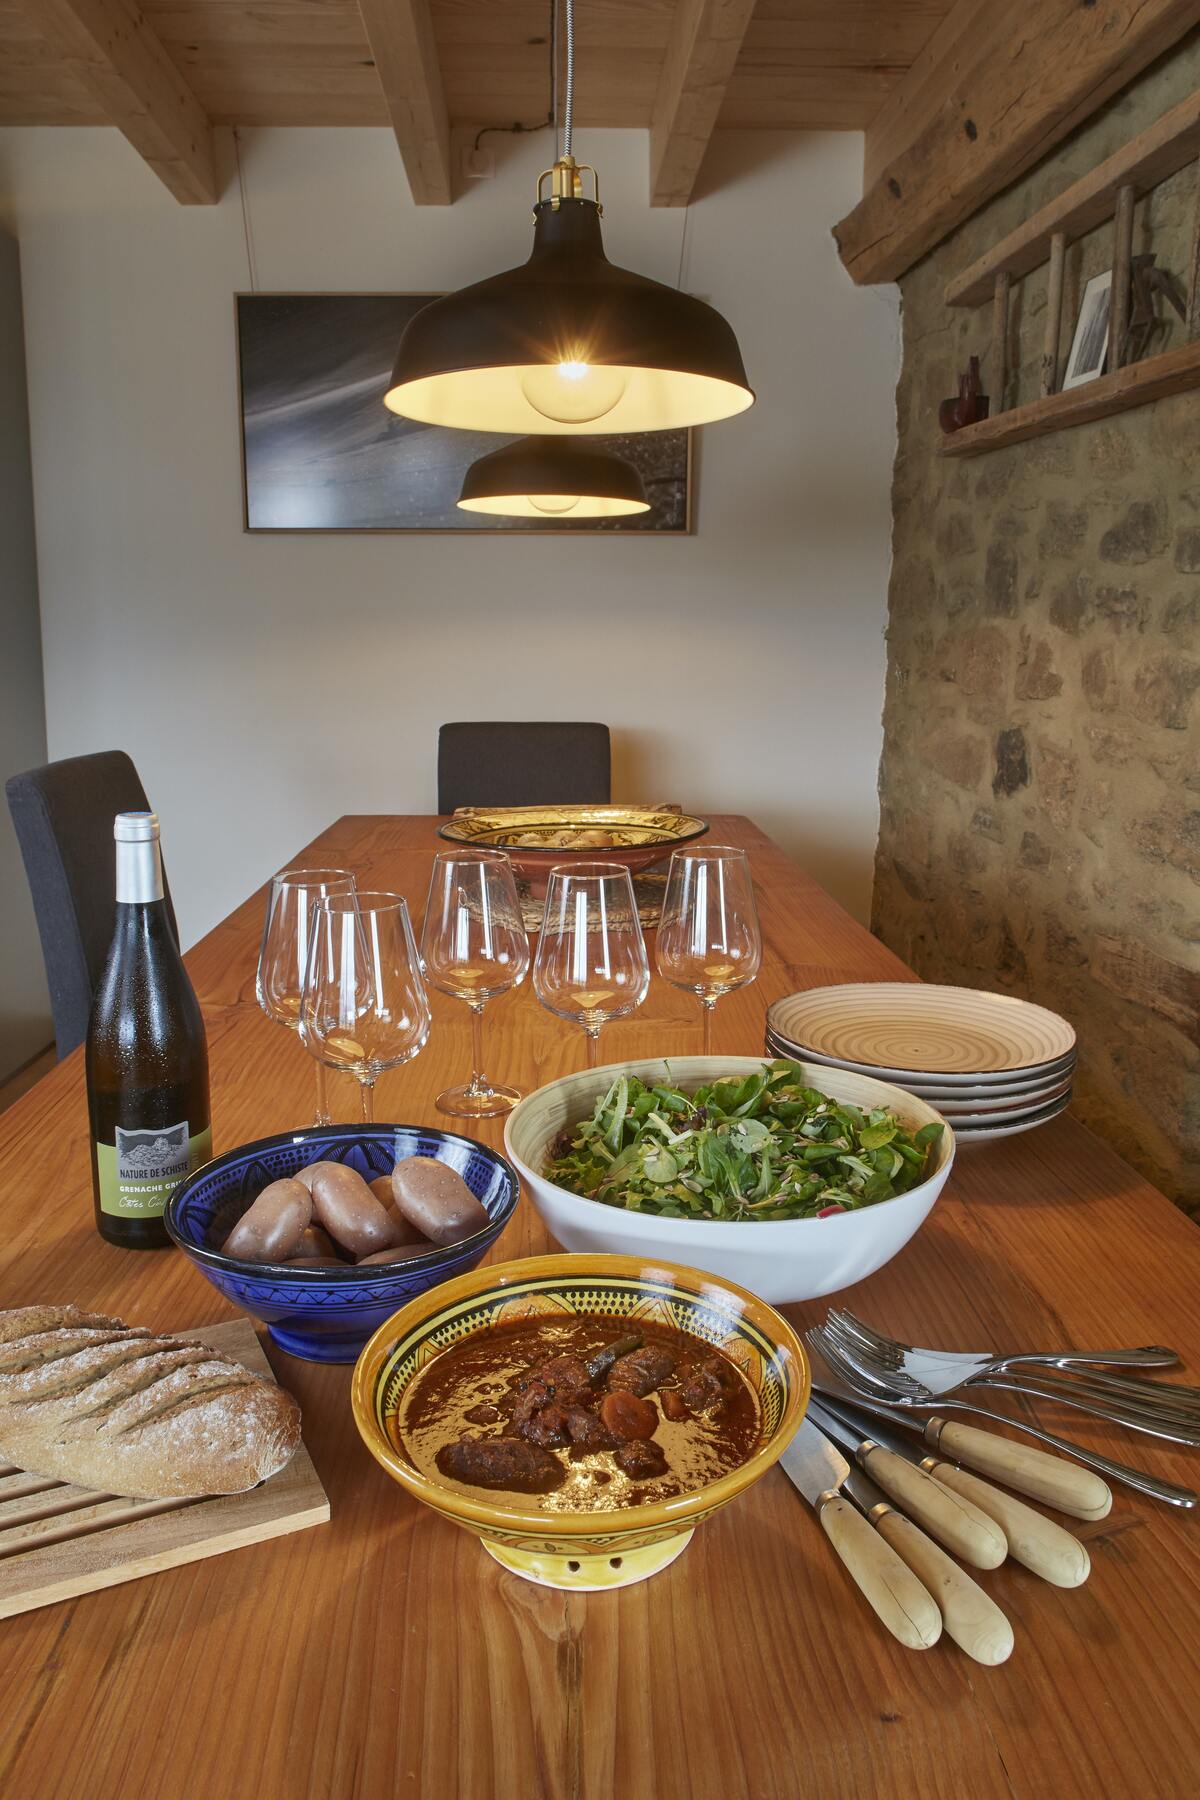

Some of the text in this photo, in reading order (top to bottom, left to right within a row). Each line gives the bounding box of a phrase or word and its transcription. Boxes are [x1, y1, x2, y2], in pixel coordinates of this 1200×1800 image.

[120, 1161, 188, 1179] NATURE DE SCHISTE
[120, 1184, 163, 1193] GRENACHE
